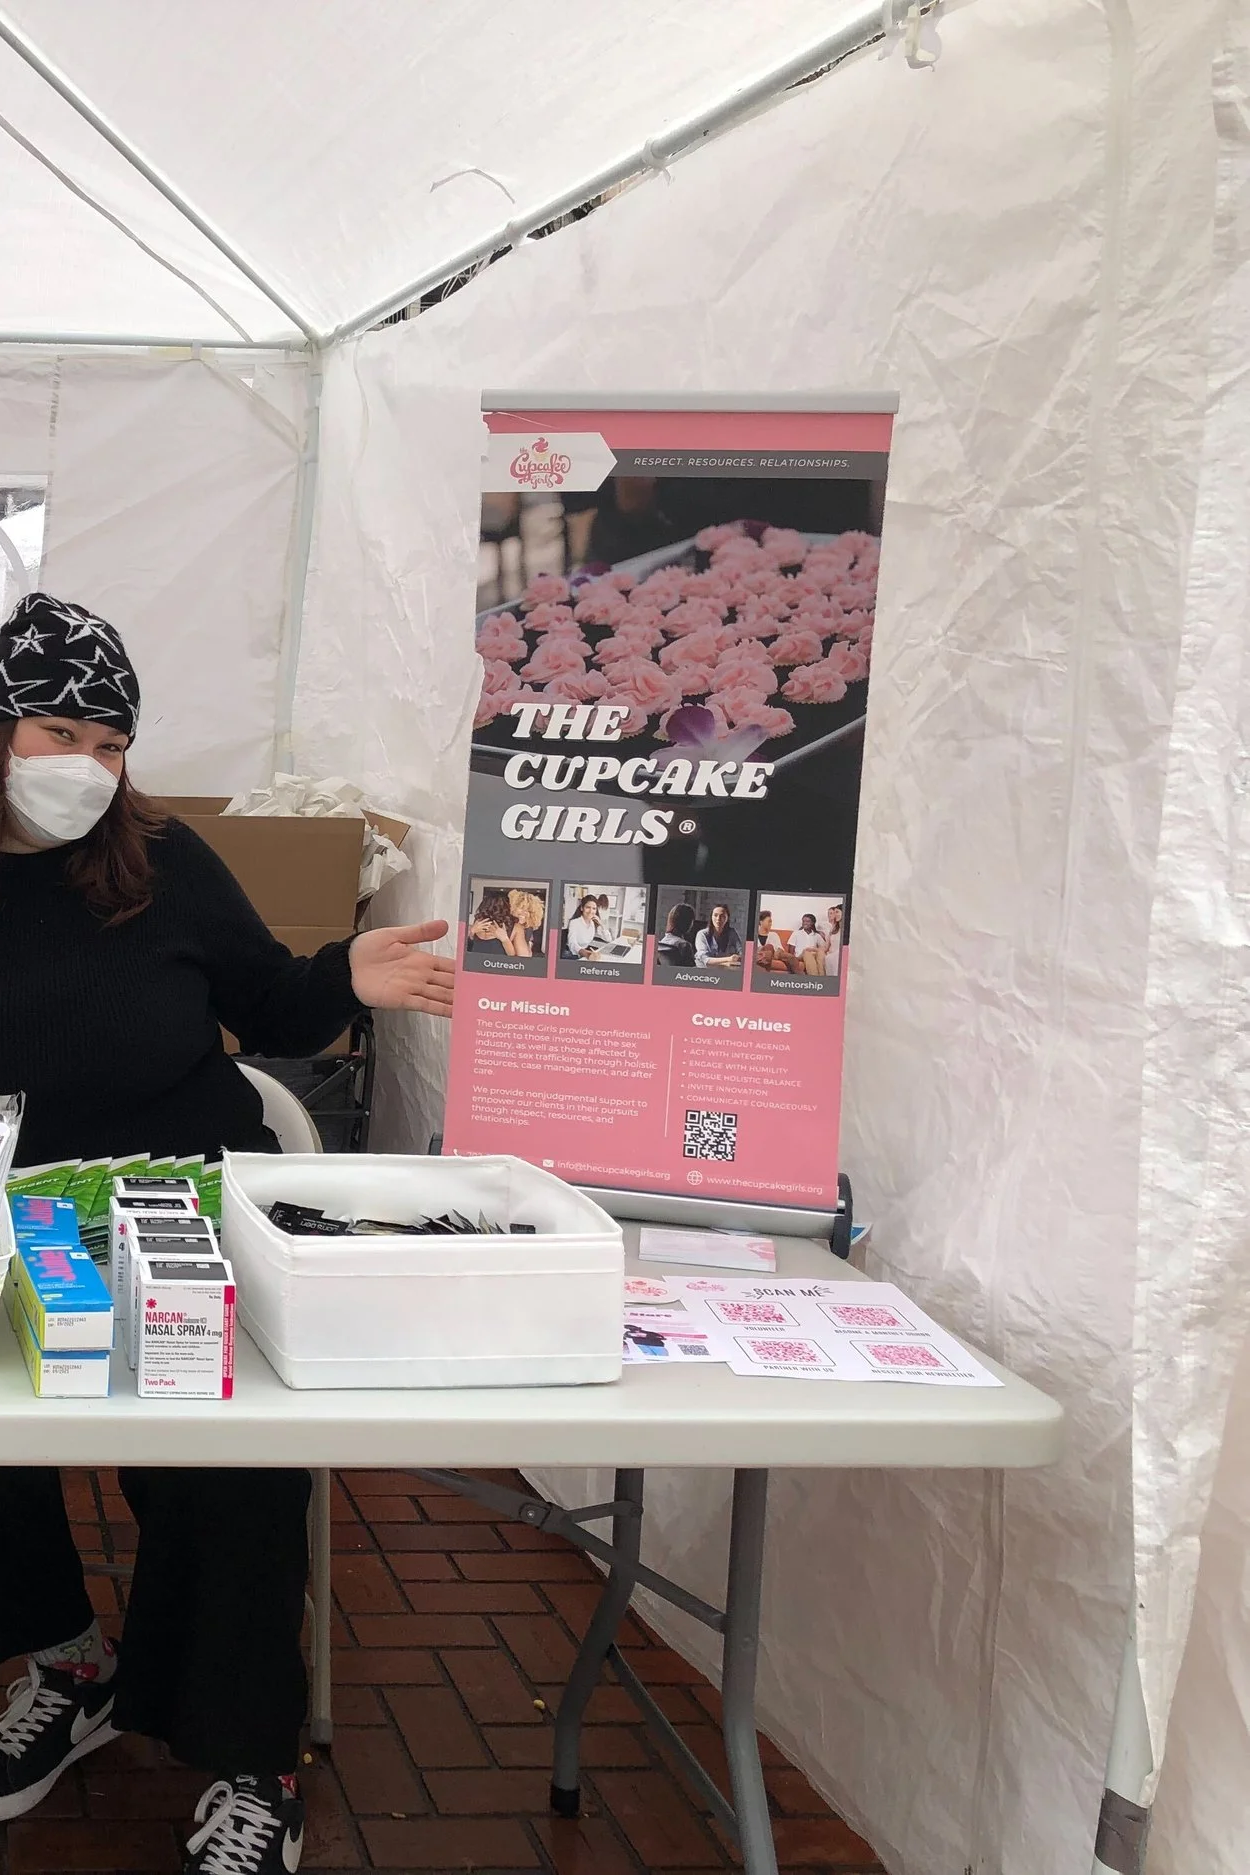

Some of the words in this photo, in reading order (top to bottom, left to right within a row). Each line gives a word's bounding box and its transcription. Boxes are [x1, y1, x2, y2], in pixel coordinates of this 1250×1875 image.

[510, 453, 572, 484] Cupcake
[634, 457, 684, 467] RESPECT.
[687, 457, 756, 468] RESOURCES.
[759, 458, 851, 469] RELATIONSHIPS.
[510, 703, 630, 741] THE
[504, 754, 776, 799] CUPCAKE
[483, 959, 525, 971] Outreach
[580, 966, 620, 978] Referrals
[675, 972, 721, 985] Advocacy
[770, 979, 823, 992] Mentorship
[478, 998, 507, 1012] Our
[511, 1000, 570, 1017] Mission
[477, 1019, 493, 1028] The
[495, 1021, 535, 1031] Cupcake
[537, 1024, 558, 1033] Girls
[559, 1026, 594, 1037] provide
[596, 1029, 651, 1040] confidential
[692, 1014, 731, 1028] Core
[735, 1017, 792, 1033] Values
[476, 1030, 510, 1040] support
[525, 1032, 550, 1042] those
[552, 1035, 590, 1045] involved
[604, 1039, 619, 1048] the
[714, 1039, 753, 1048] WITHOUT
[755, 1043, 791, 1051] AGENDA
[475, 1039, 514, 1050] industry,
[527, 1043, 546, 1051] well
[561, 1045, 586, 1055] those
[588, 1047, 626, 1058] affected
[628, 1051, 640, 1059] by
[708, 1050, 729, 1058] WITH
[731, 1052, 774, 1061] INTEGRITY
[475, 1048, 516, 1058] domestic
[536, 1052, 581, 1065] trafficking
[583, 1057, 622, 1068] through
[624, 1060, 657, 1070] holistic
[689, 1060, 723, 1069] ENGAGE
[725, 1063, 747, 1071] WITH
[749, 1066, 789, 1074] HUMILITY
[473, 1067, 494, 1076] care.
[475, 1059, 519, 1069] resources,
[521, 1062, 541, 1070] case
[543, 1064, 609, 1076] management,
[610, 1068, 629, 1077] and
[631, 1070, 652, 1079] after
[688, 1072, 721, 1081] PURSUE
[723, 1075, 761, 1084] HOLISTIC
[763, 1078, 802, 1088] BALANCE
[472, 1085, 488, 1094] We
[490, 1086, 524, 1097] provide
[526, 1090, 597, 1103] nonjudgmental
[599, 1095, 635, 1107] support
[637, 1100, 648, 1108] to
[687, 1083, 714, 1092] INVITE
[716, 1085, 768, 1096] INNOVATION
[472, 1095, 515, 1106] empower
[535, 1100, 565, 1110] clients
[577, 1104, 599, 1112] their
[601, 1107, 638, 1117] pursuits
[686, 1095, 749, 1106] COMMUNICATE
[750, 1100, 818, 1111] COURAGEOUSLY
[471, 1104, 508, 1115] through
[510, 1108, 546, 1118] respect,
[548, 1112, 594, 1122] resources,
[596, 1116, 614, 1124] and
[471, 1113, 530, 1126] relationships.
[557, 1161, 671, 1181] info@thecupcakegirls.org
[707, 1176, 823, 1196] www.thecupcakegirls.org
[752, 1287, 797, 1298] SCAN
[145, 1324, 175, 1336] NASAL
[177, 1325, 207, 1337] SPRAY
[212, 1330, 223, 1338] mg
